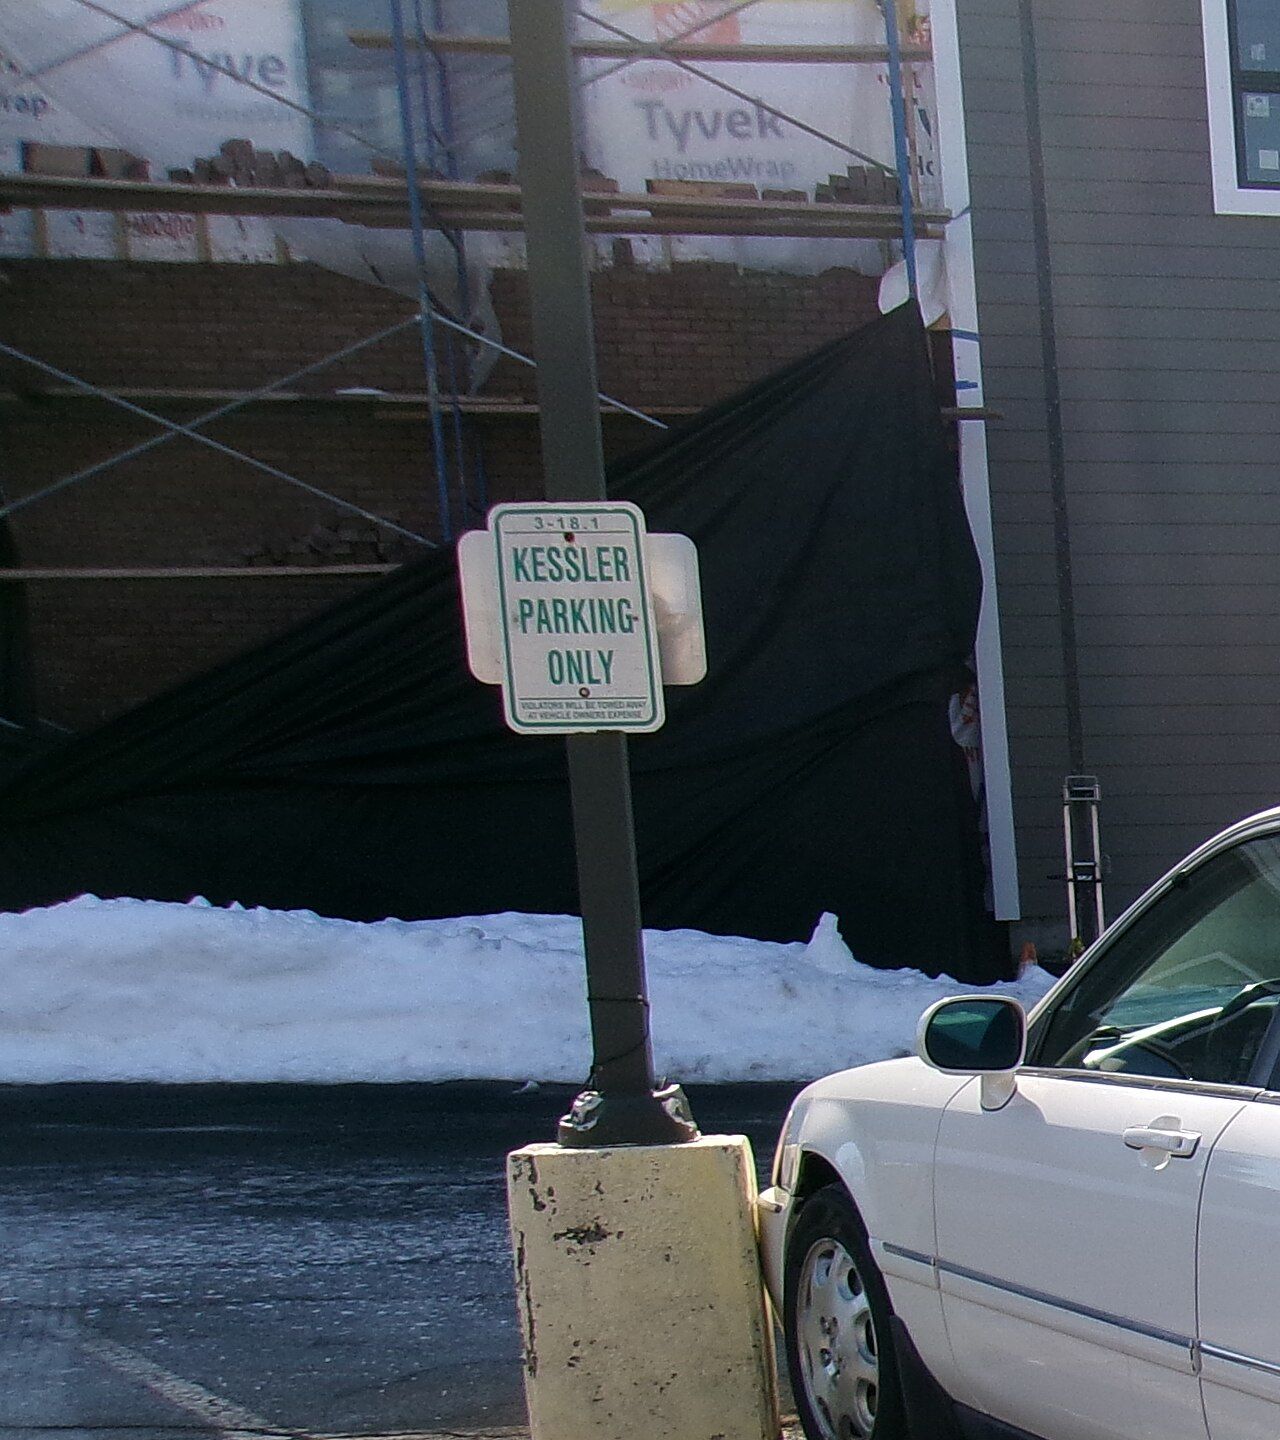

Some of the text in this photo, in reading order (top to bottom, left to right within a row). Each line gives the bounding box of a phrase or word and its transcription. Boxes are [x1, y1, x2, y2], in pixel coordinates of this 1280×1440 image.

[631, 97, 786, 152] Tyvek
[652, 157, 797, 181] HomeWrap
[512, 546, 631, 583] KESSLER
[518, 598, 636, 635] PARKING
[547, 649, 614, 685] ONLY
